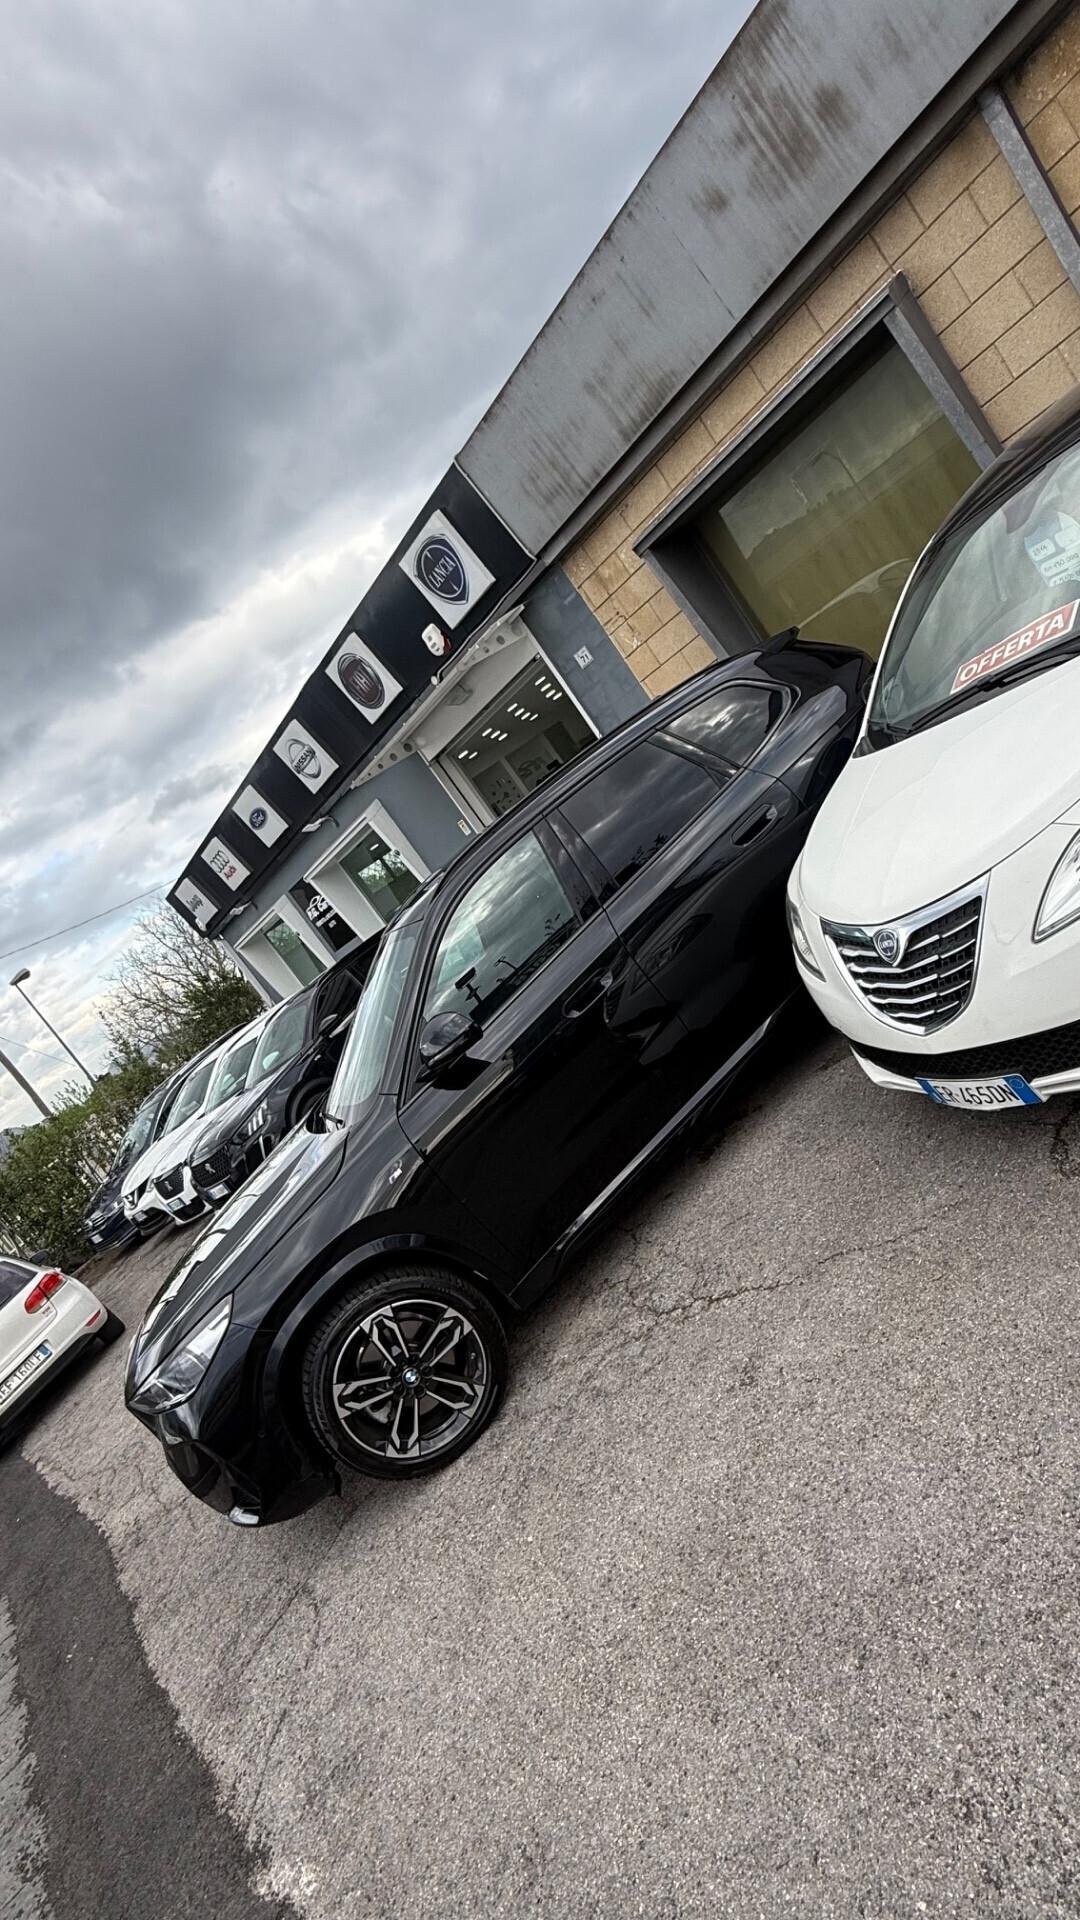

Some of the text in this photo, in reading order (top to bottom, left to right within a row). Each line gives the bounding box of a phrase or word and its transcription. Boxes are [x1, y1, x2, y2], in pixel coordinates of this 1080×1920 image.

[428, 556, 456, 588] LANCIA
[580, 653, 590, 663] 71
[960, 613, 1064, 681] OFFERTA
[293, 749, 313, 770] NISSAN
